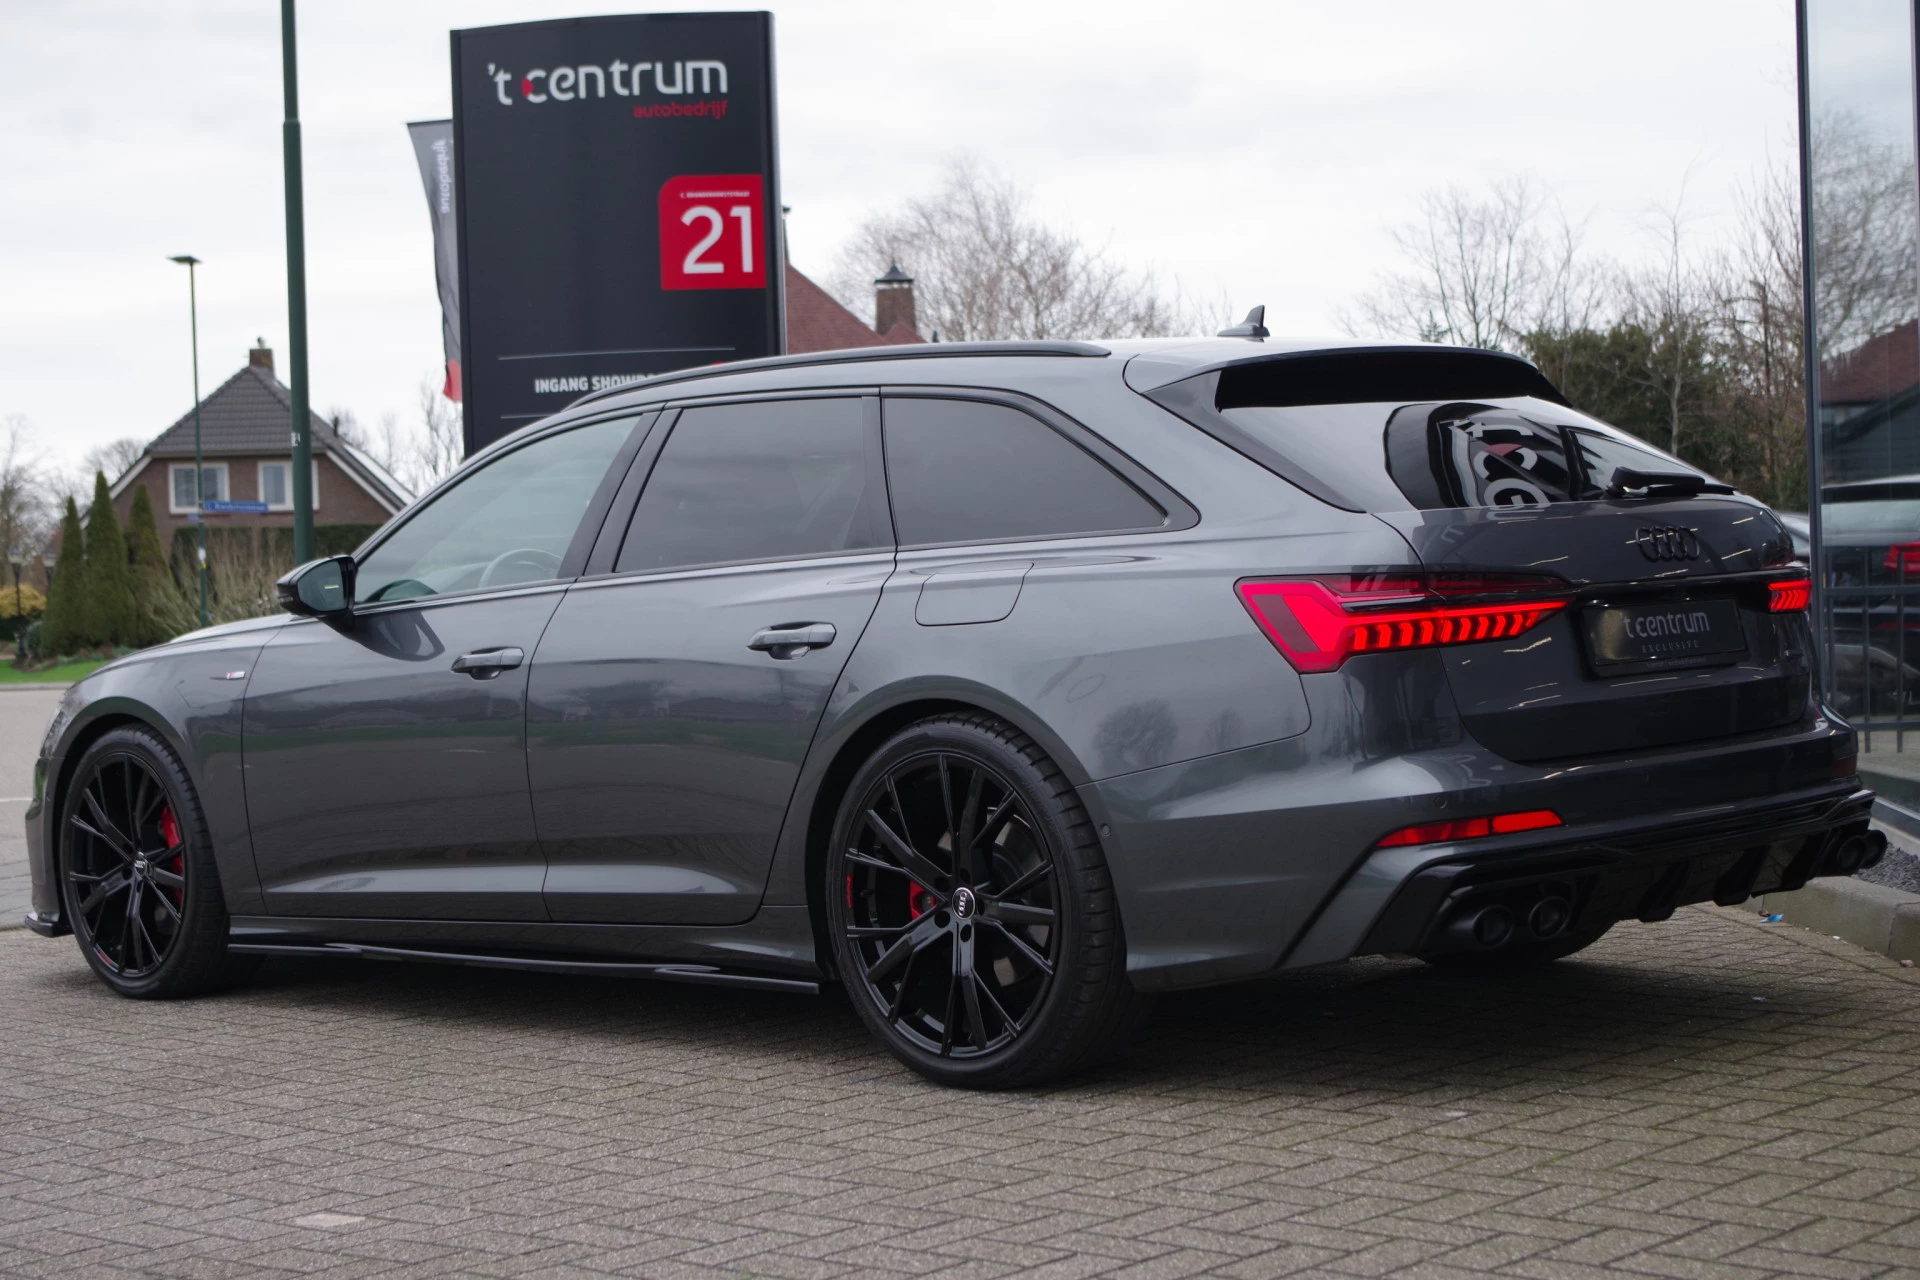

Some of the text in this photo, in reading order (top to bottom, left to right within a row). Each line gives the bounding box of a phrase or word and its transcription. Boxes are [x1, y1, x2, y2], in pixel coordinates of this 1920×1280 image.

[488, 59, 728, 105] 't centrum
[633, 99, 729, 119] autobedrijf
[680, 205, 754, 274] 21
[535, 373, 656, 393] INGANG SHOW
[1635, 611, 1710, 637] centrum
[1641, 639, 1701, 654] EXCLUSIVE
